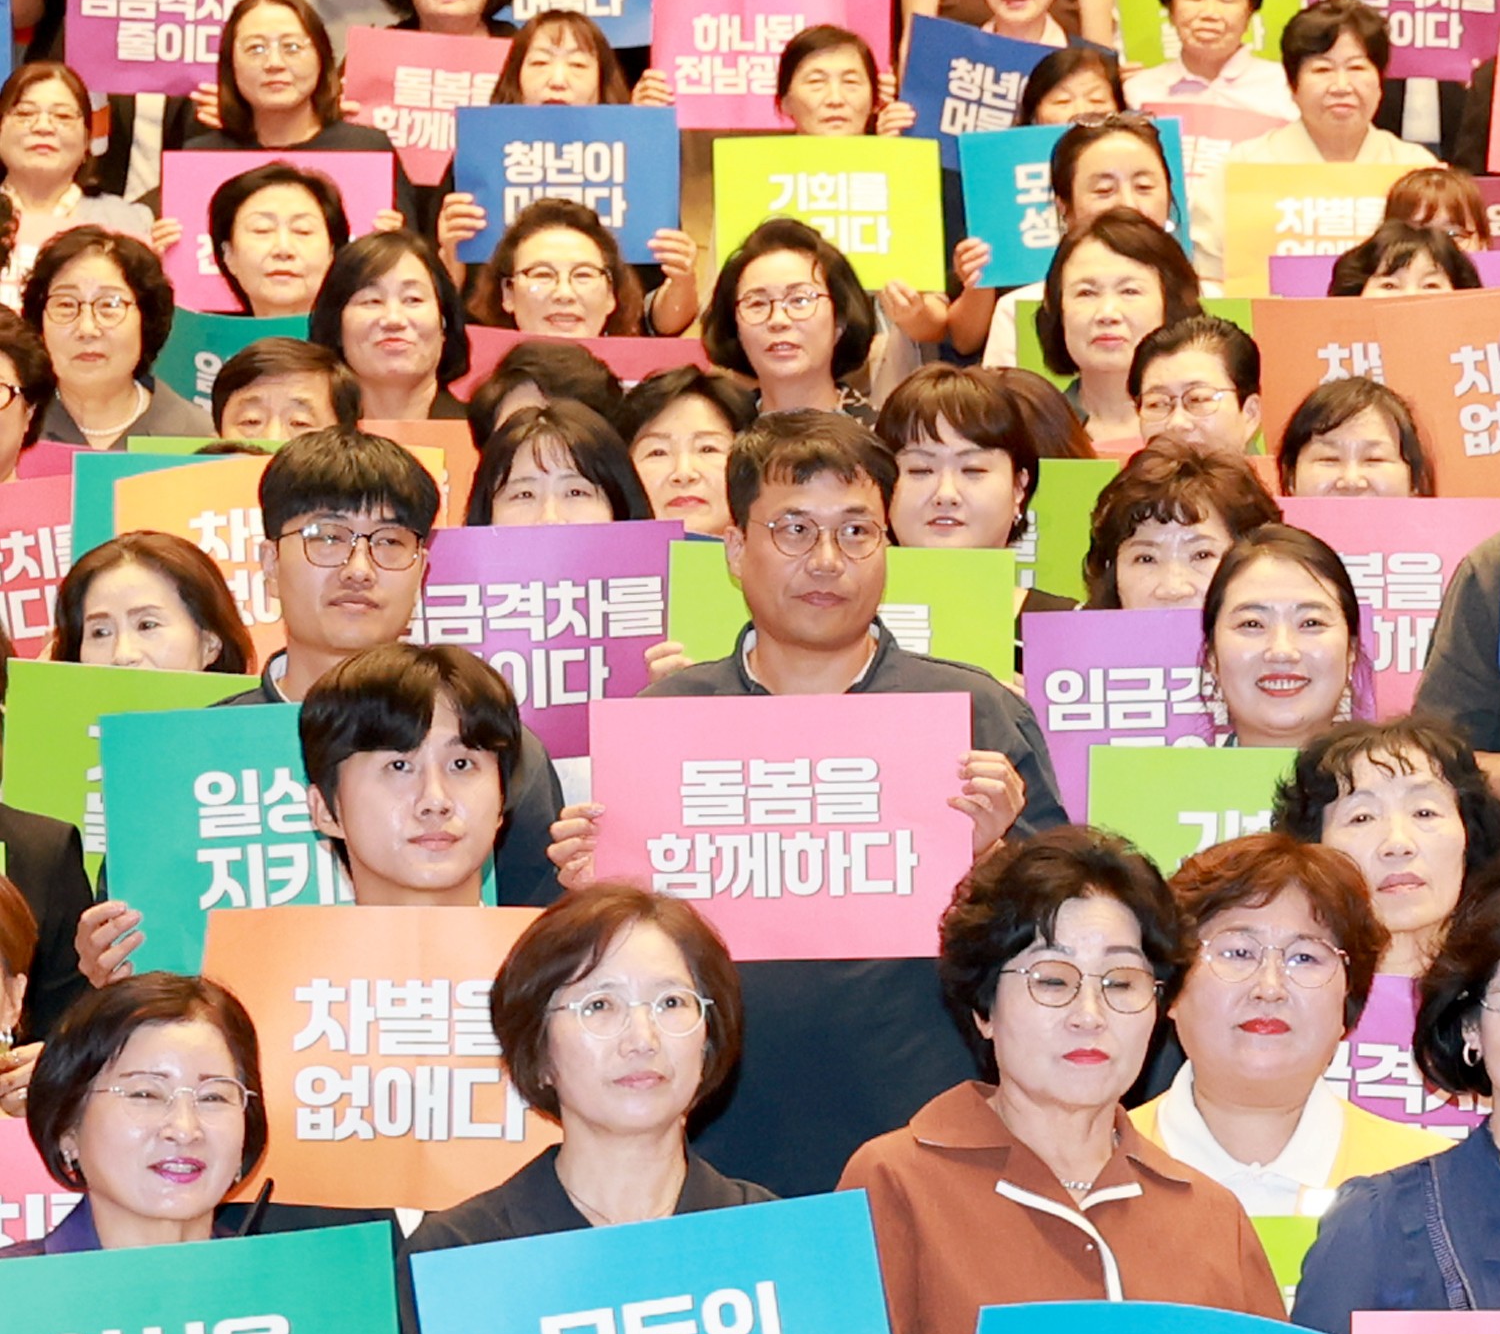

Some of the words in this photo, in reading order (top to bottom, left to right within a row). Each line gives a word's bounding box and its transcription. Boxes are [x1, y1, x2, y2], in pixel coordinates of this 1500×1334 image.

[692, 13, 805, 54] 하나된
[1390, 11, 1463, 48] 이다
[674, 55, 779, 95] 전남광
[504, 141, 625, 184] 청년이
[770, 173, 888, 211] 기회를
[1275, 197, 1385, 236] 차별을
[681, 759, 879, 825] 돌봄을
[648, 830, 917, 898] 함께하다
[294, 1065, 526, 1141] 없애다
